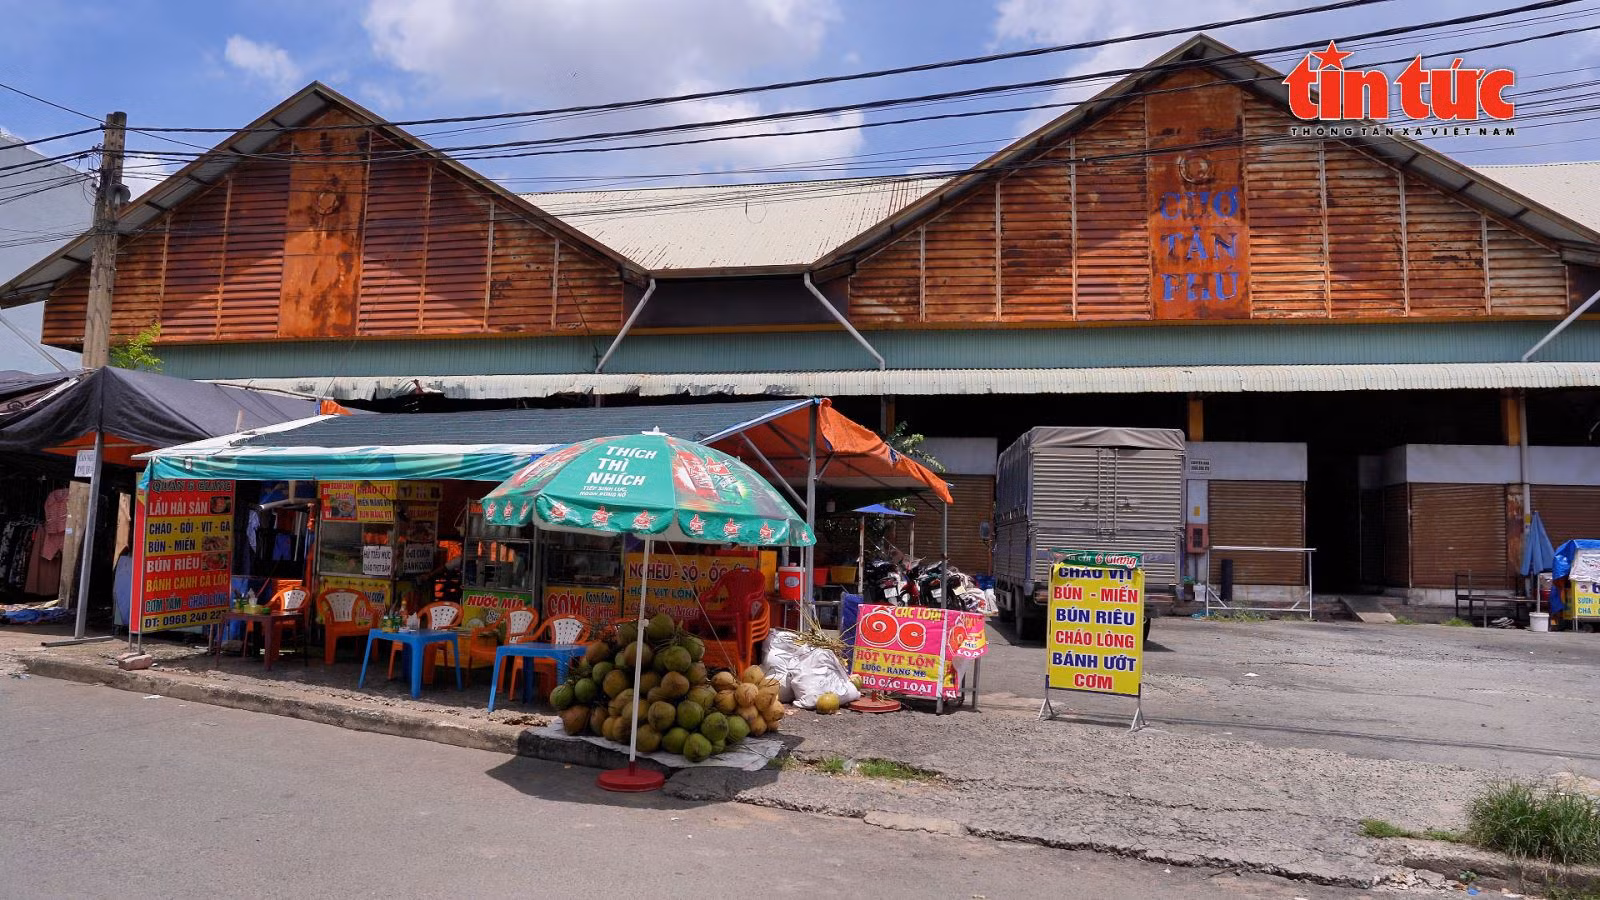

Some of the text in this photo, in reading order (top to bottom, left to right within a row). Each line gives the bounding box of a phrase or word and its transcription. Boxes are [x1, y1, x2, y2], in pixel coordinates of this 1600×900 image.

[606, 446, 657, 460] THÍCH
[598, 457, 629, 472] THÌ
[586, 471, 646, 486] NHÍCH
[170, 497, 187, 515] HẢI
[189, 497, 208, 515] SẢN
[149, 521, 172, 535] CHÁO
[149, 540, 166, 553] BÚN
[147, 556, 200, 573] BÚN RIÊU
[146, 576, 171, 593] BÁNH
[174, 575, 198, 590] CANH
[467, 593, 498, 607] NƯỚC
[1054, 583, 1138, 603] BÚN MIẾN
[548, 588, 582, 616] CƠM
[1056, 606, 1135, 625] BÚN RIÊU
[1055, 629, 1134, 648] CHÁO LÒNG
[856, 651, 935, 669] HỘT VỊT LỘN
[1052, 650, 1136, 671] BÁNH ƯỚT
[887, 667, 911, 676] RANG
[862, 674, 876, 686] HÔ
[879, 677, 901, 689] CÁC
[904, 682, 932, 695] LOẠI
[1074, 673, 1113, 689] CƠM
